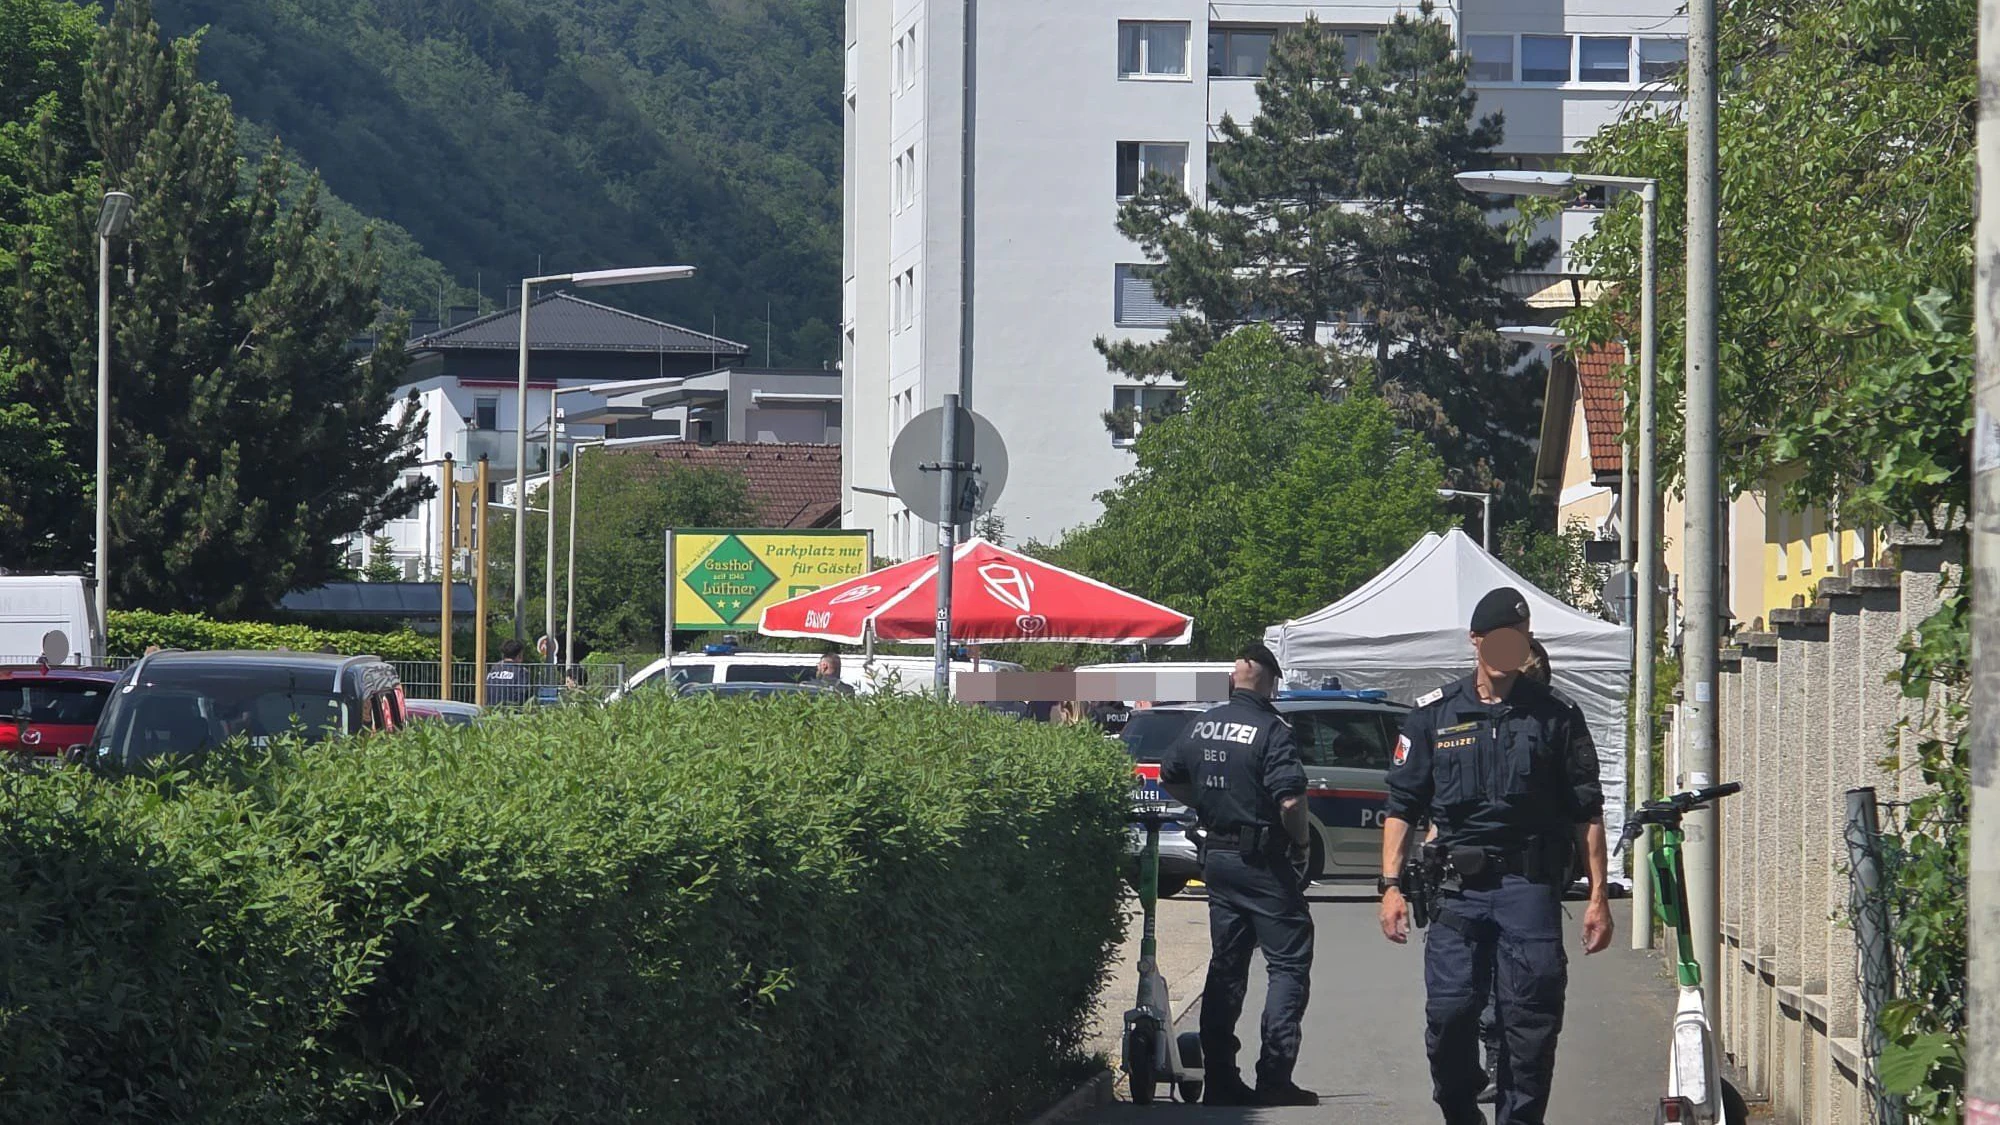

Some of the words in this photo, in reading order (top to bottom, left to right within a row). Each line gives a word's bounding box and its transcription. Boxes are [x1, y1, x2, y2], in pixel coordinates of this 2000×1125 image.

[765, 544, 835, 559] Parkplatz
[839, 547, 863, 557] nur
[704, 558, 754, 571] Gasthof
[790, 561, 813, 577] für
[817, 562, 862, 574] Gäste!
[804, 609, 831, 629] ESKIMO
[1190, 720, 1258, 745] POLIZEI
[1437, 737, 1476, 749] POLIZEI
[1206, 774, 1225, 789] 411
